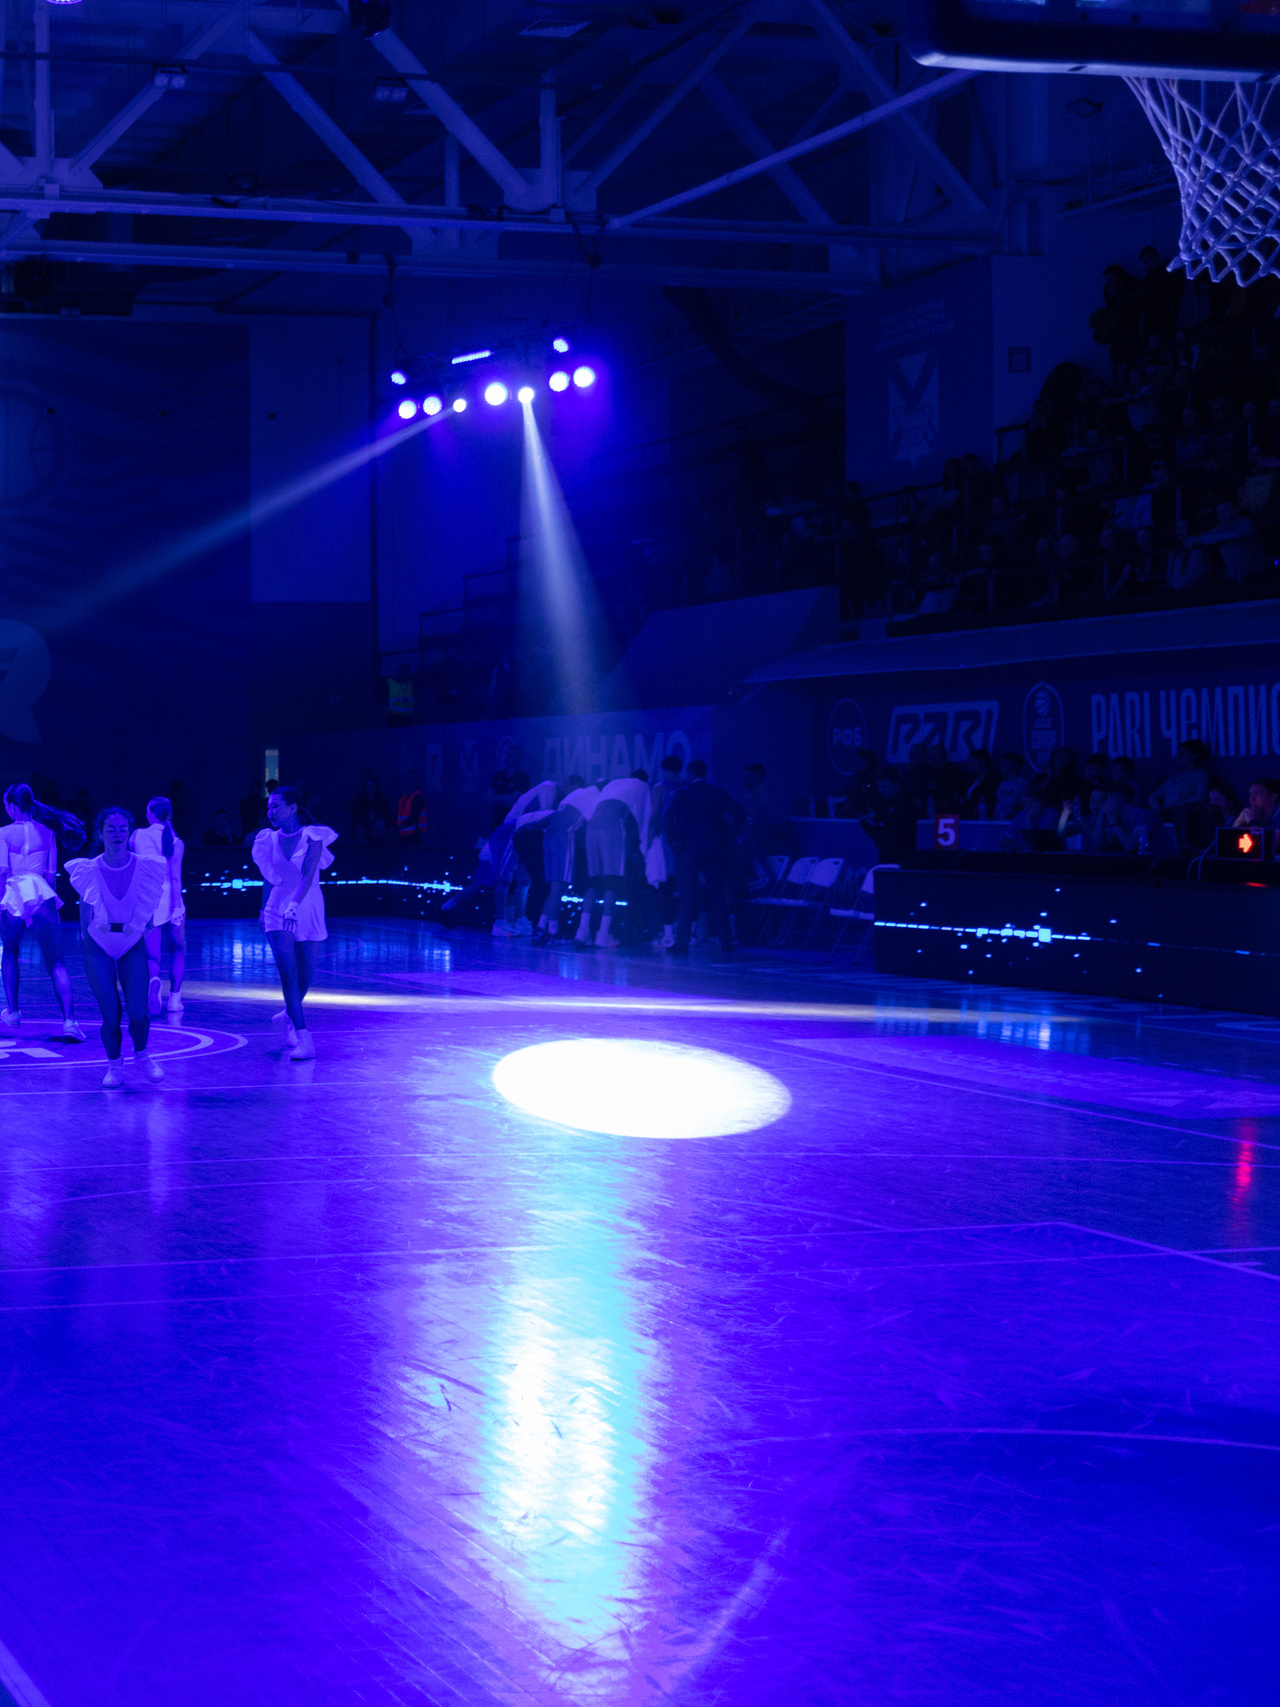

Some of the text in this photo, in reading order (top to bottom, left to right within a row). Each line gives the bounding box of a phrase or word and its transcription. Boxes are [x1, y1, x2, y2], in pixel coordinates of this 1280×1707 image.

[832, 726, 863, 748] РФБ
[891, 709, 993, 756] PARI
[1091, 691, 1152, 759] PARI
[543, 731, 692, 782] ДИНАМО
[936, 817, 956, 847] 5
